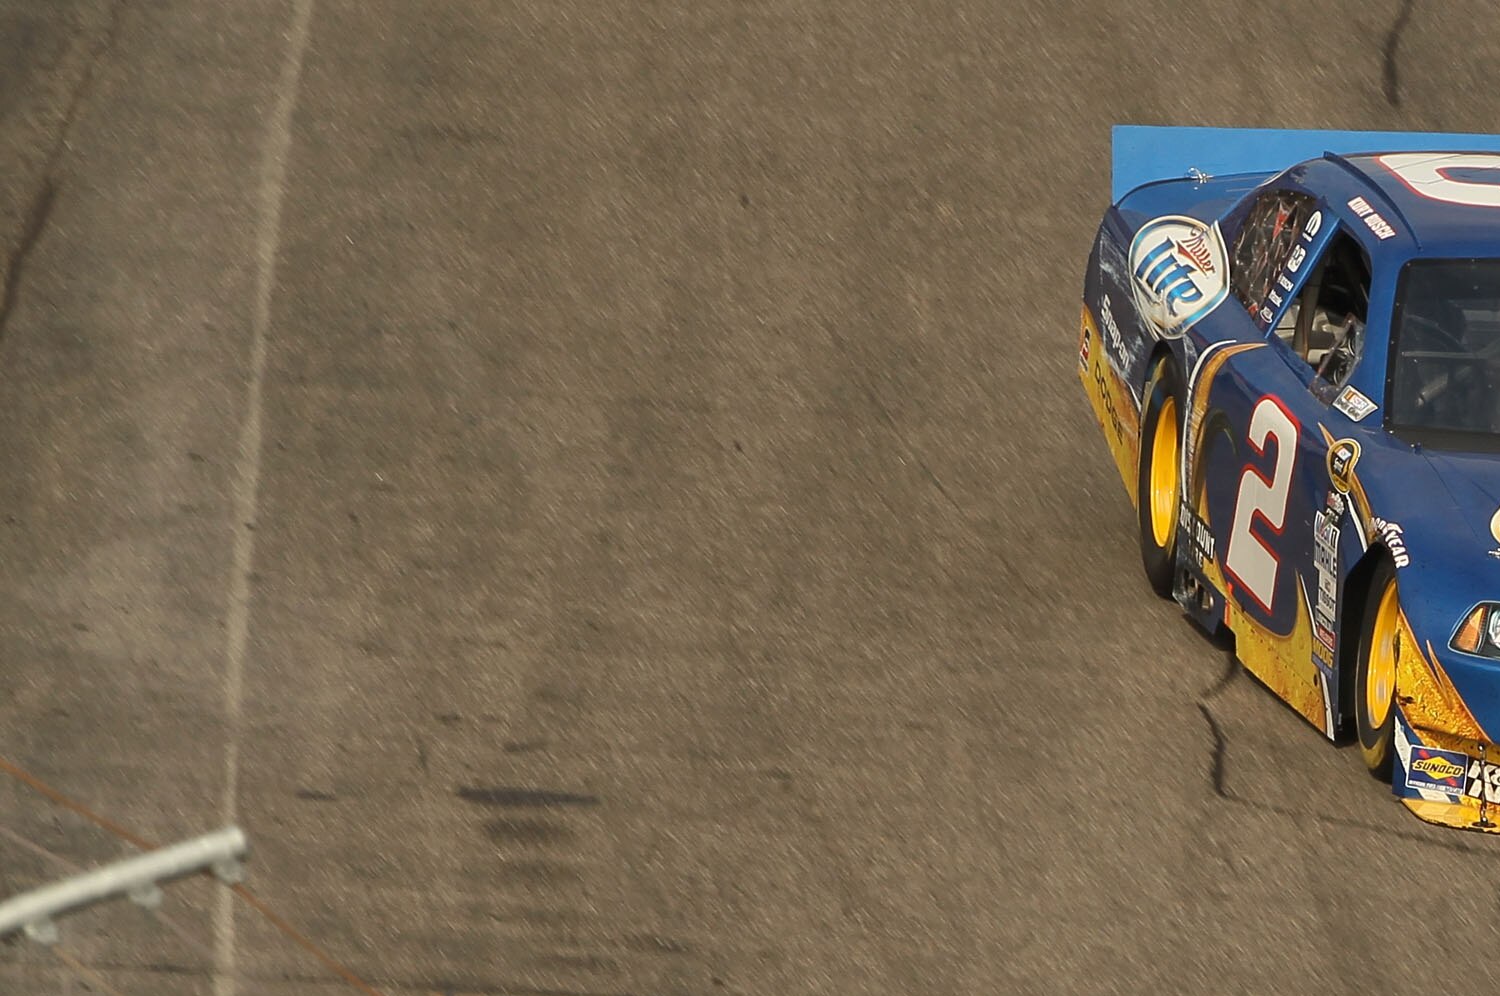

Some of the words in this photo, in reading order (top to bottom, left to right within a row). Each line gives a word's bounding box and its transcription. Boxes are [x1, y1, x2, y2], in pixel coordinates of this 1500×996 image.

[1134, 236, 1204, 317] Lite
[1175, 226, 1217, 281] Miller
[1226, 396, 1297, 615] 2
[1413, 760, 1464, 776] SUNOCO
